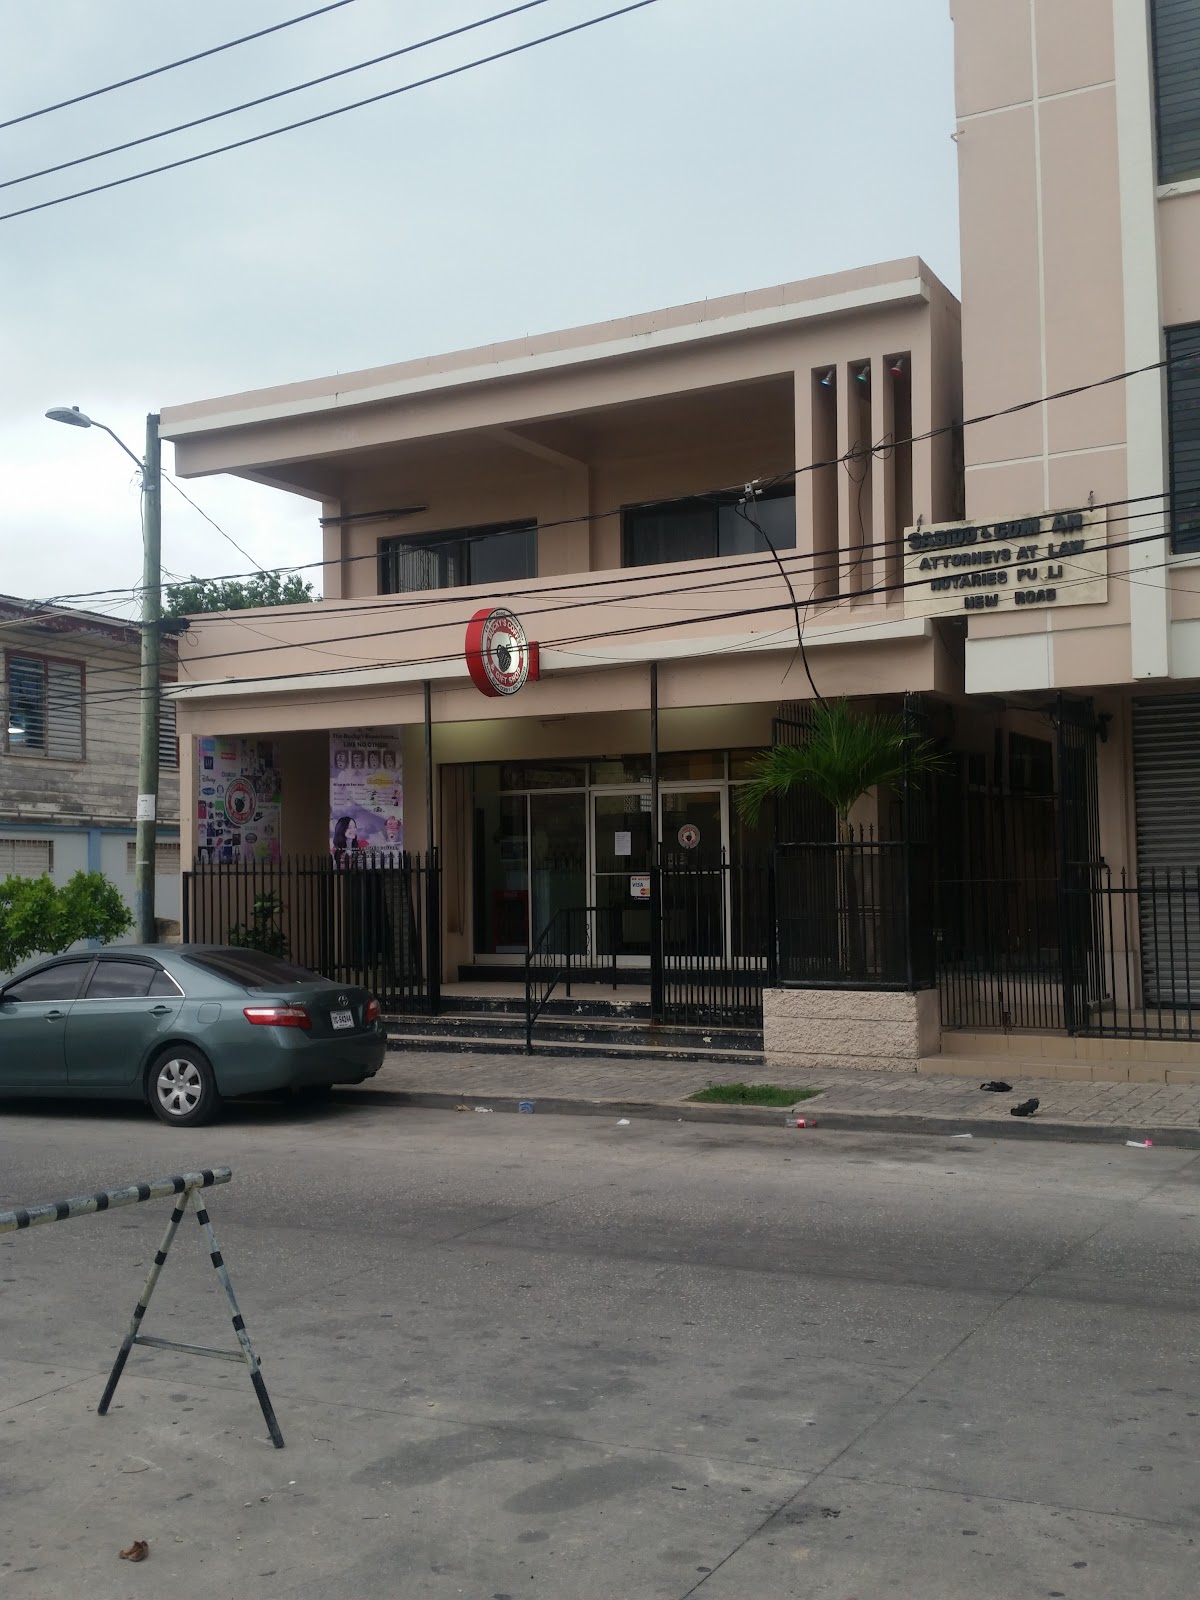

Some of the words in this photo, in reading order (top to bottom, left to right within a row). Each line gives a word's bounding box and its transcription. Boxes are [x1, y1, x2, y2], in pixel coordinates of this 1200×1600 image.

[918, 548, 1012, 571] ATTORNEYS
[1016, 545, 1038, 560] AT
[1047, 540, 1085, 557] LAW
[930, 571, 1008, 592] NOTARIES
[964, 594, 999, 609] NEW
[1014, 588, 1056, 605] ROAD
[495, 671, 508, 684] GIFT
[508, 667, 521, 684] SHOP
